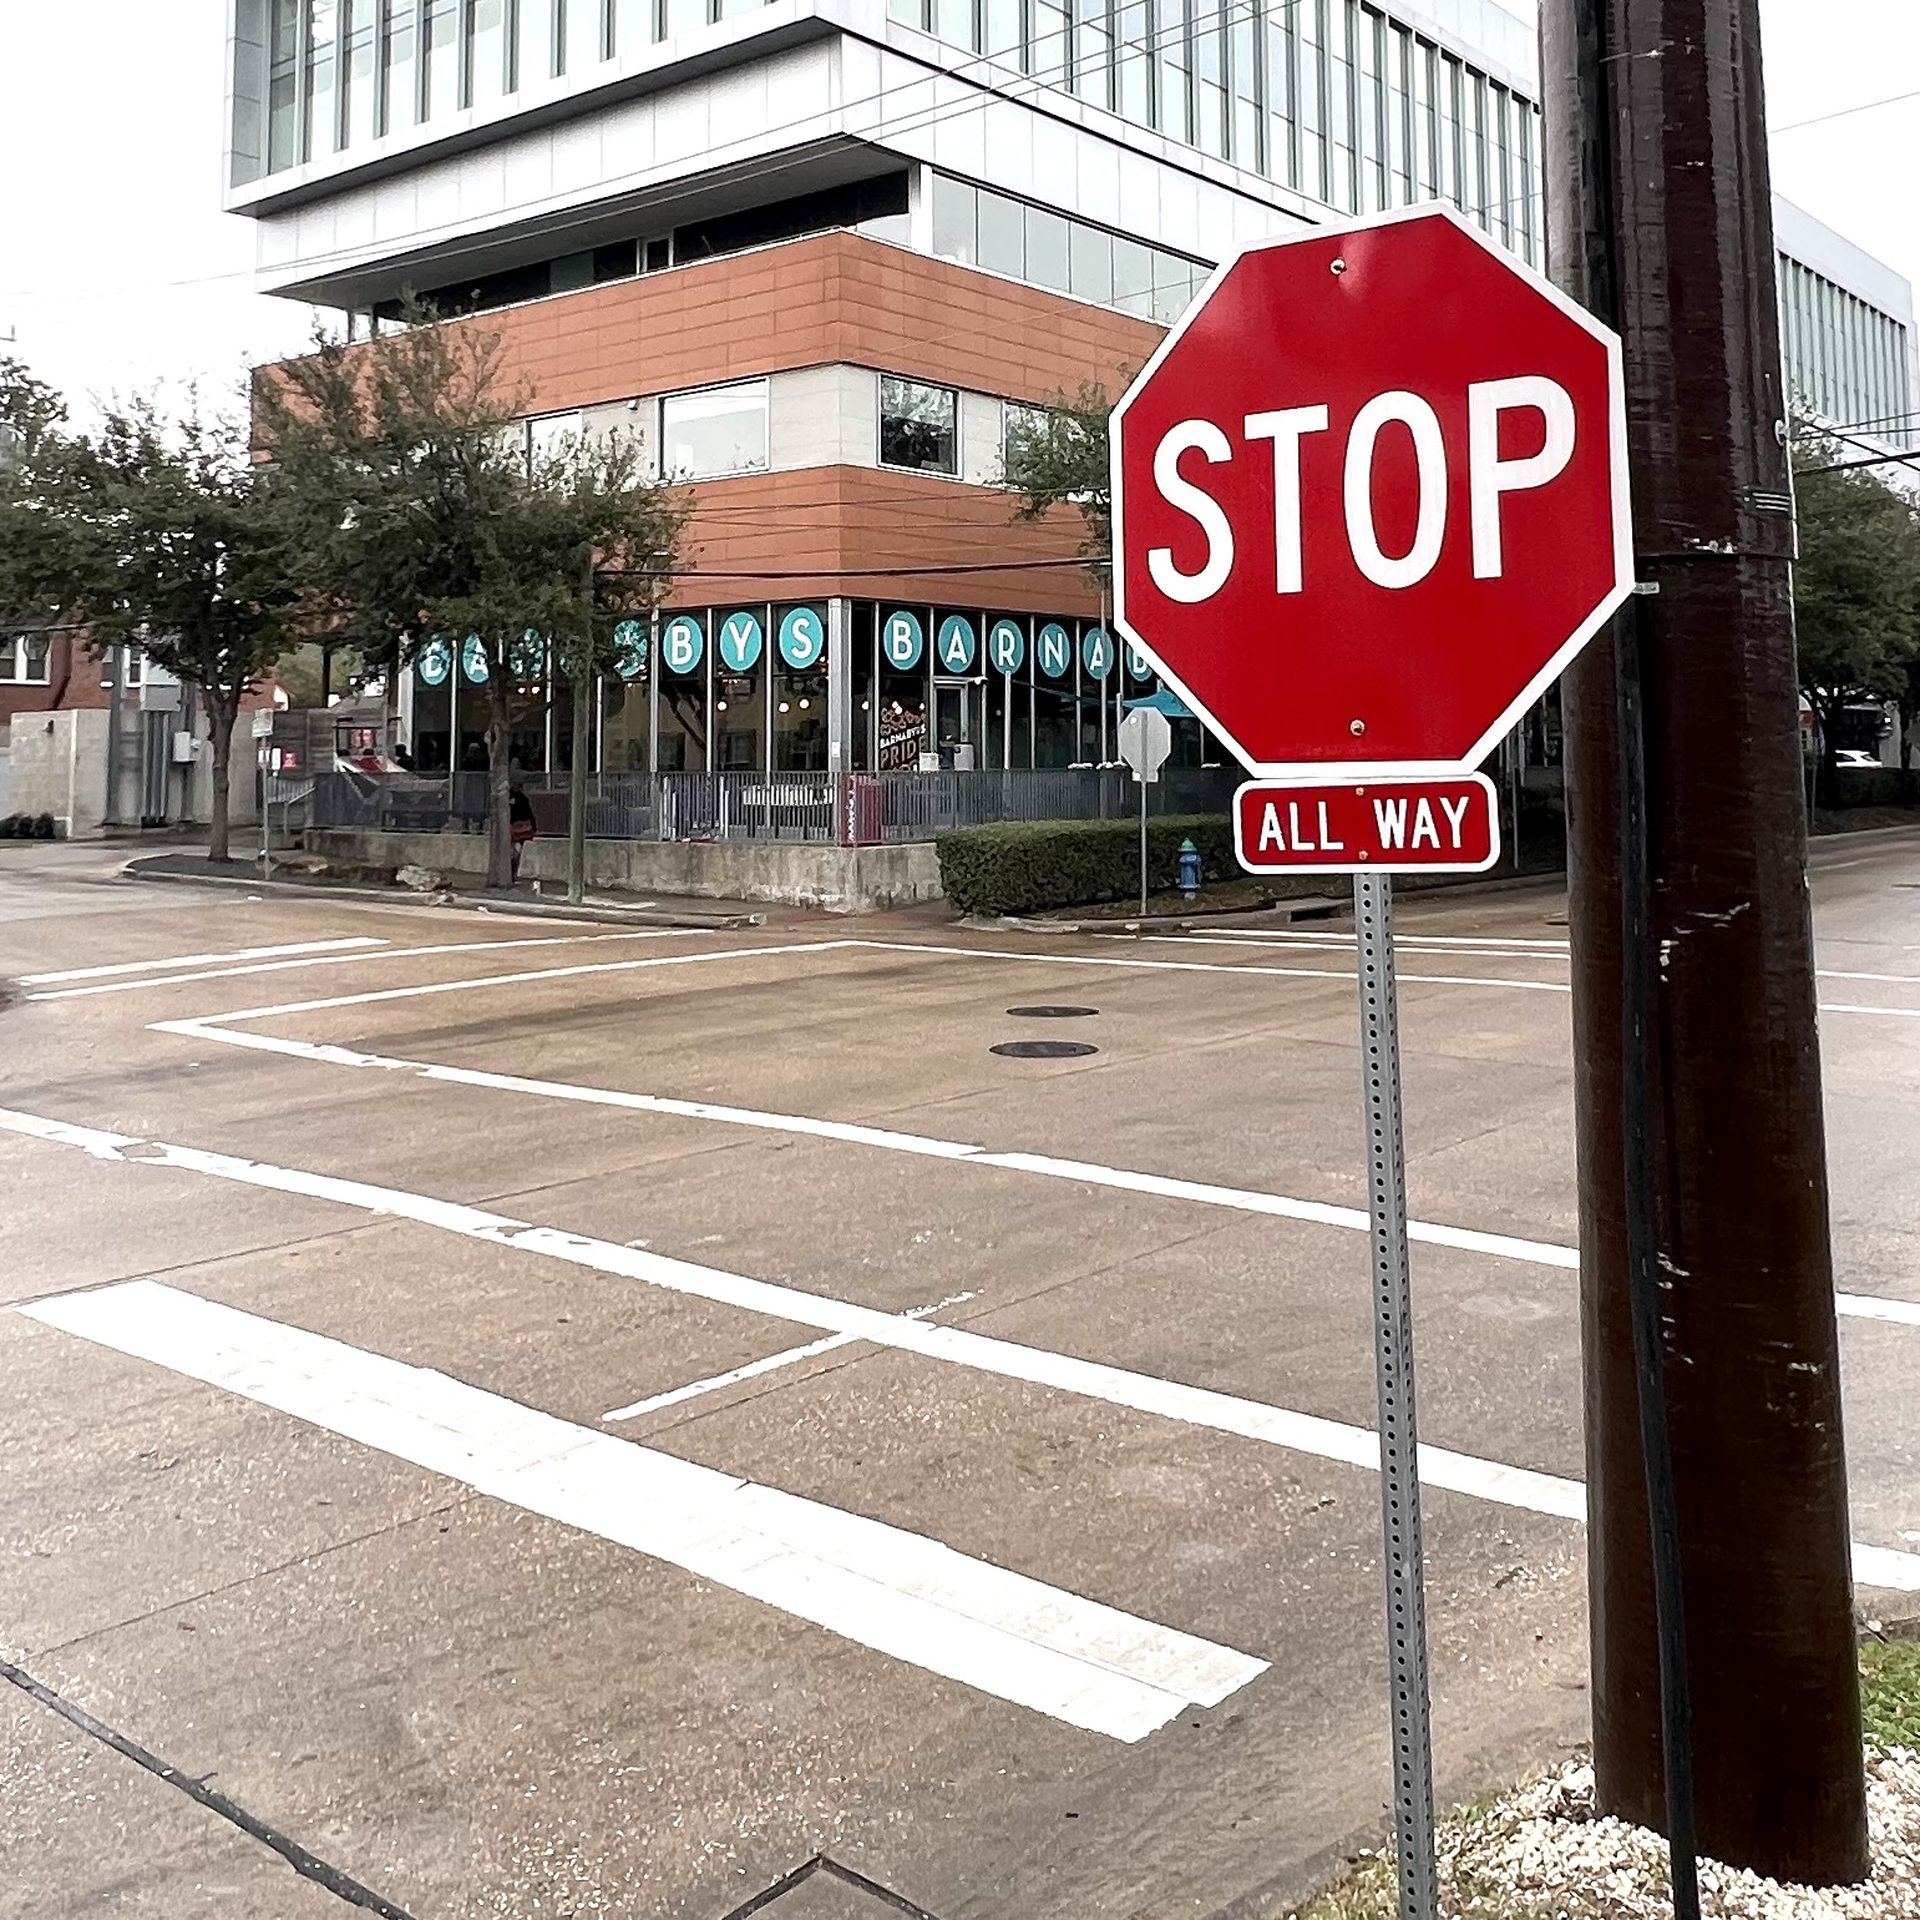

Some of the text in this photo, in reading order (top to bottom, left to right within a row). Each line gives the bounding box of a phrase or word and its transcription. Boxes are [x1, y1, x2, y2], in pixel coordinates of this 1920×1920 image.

[1147, 375, 1577, 604] STOP
[1258, 796, 1469, 851] ALL WAY
